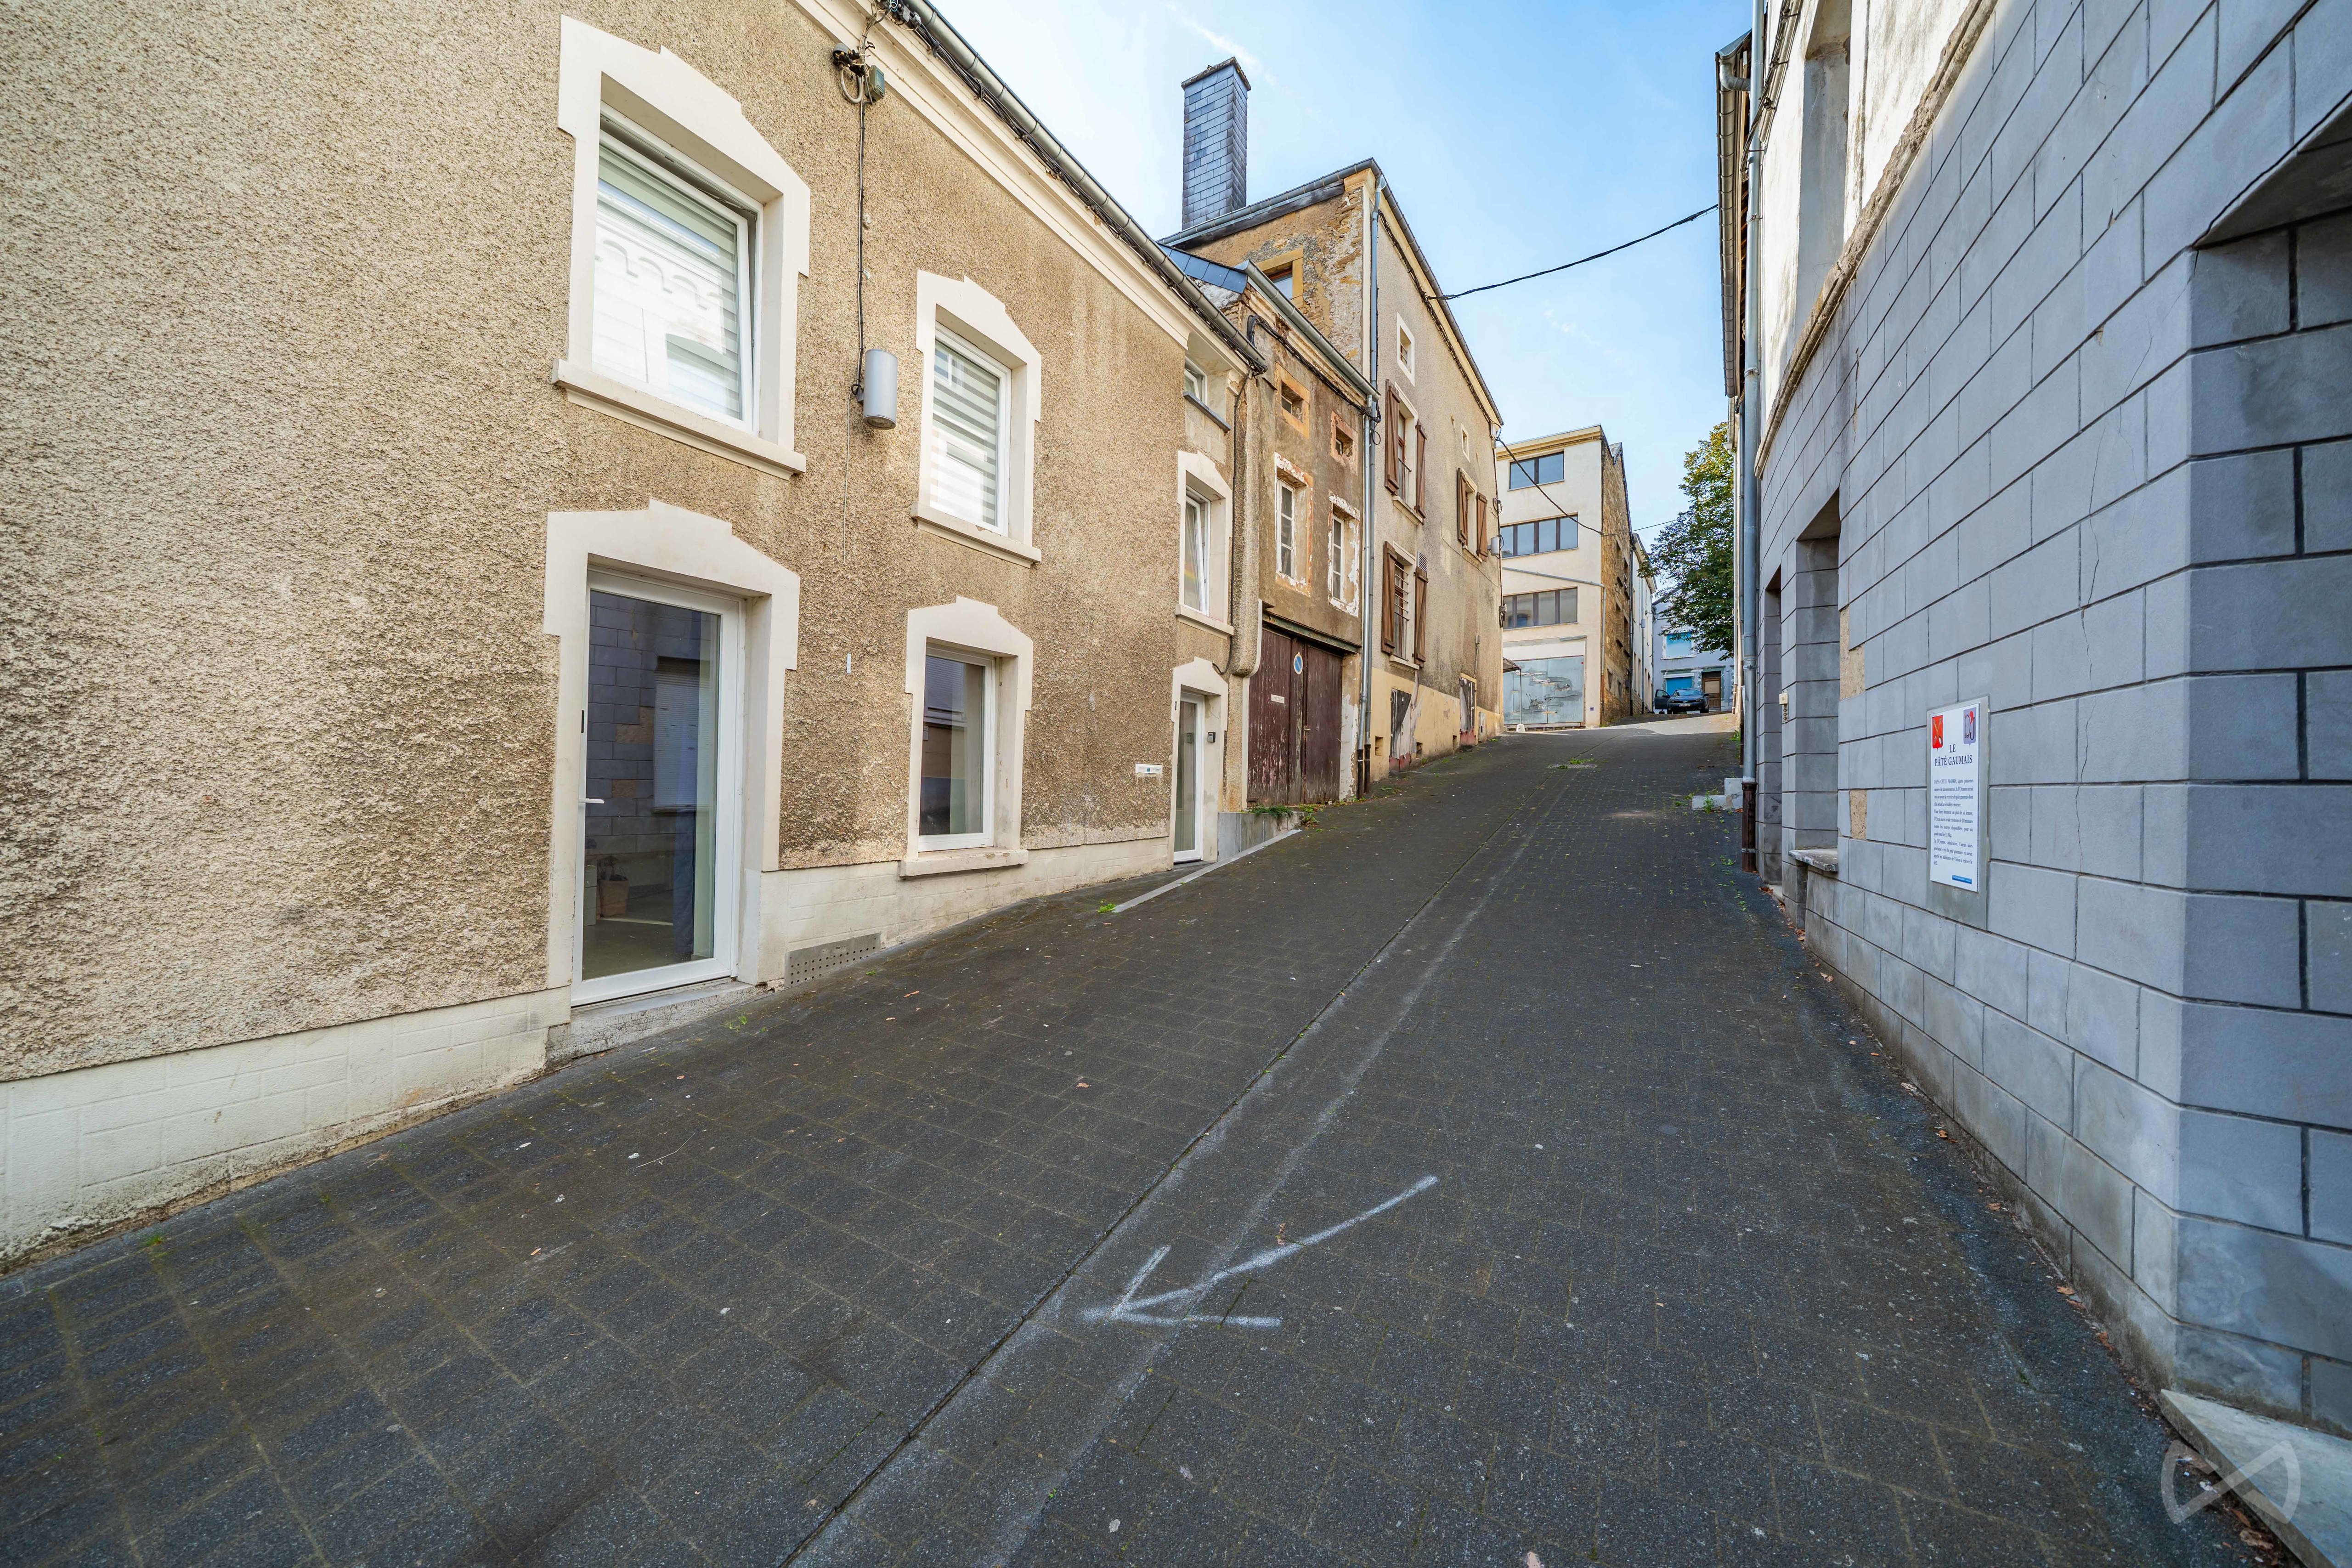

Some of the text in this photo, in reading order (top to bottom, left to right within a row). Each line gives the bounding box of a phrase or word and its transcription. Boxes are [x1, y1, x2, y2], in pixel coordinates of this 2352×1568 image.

[1950, 744, 1956, 753] LE
[1935, 754, 1972, 766] PÂTÉ GAUMAIS
